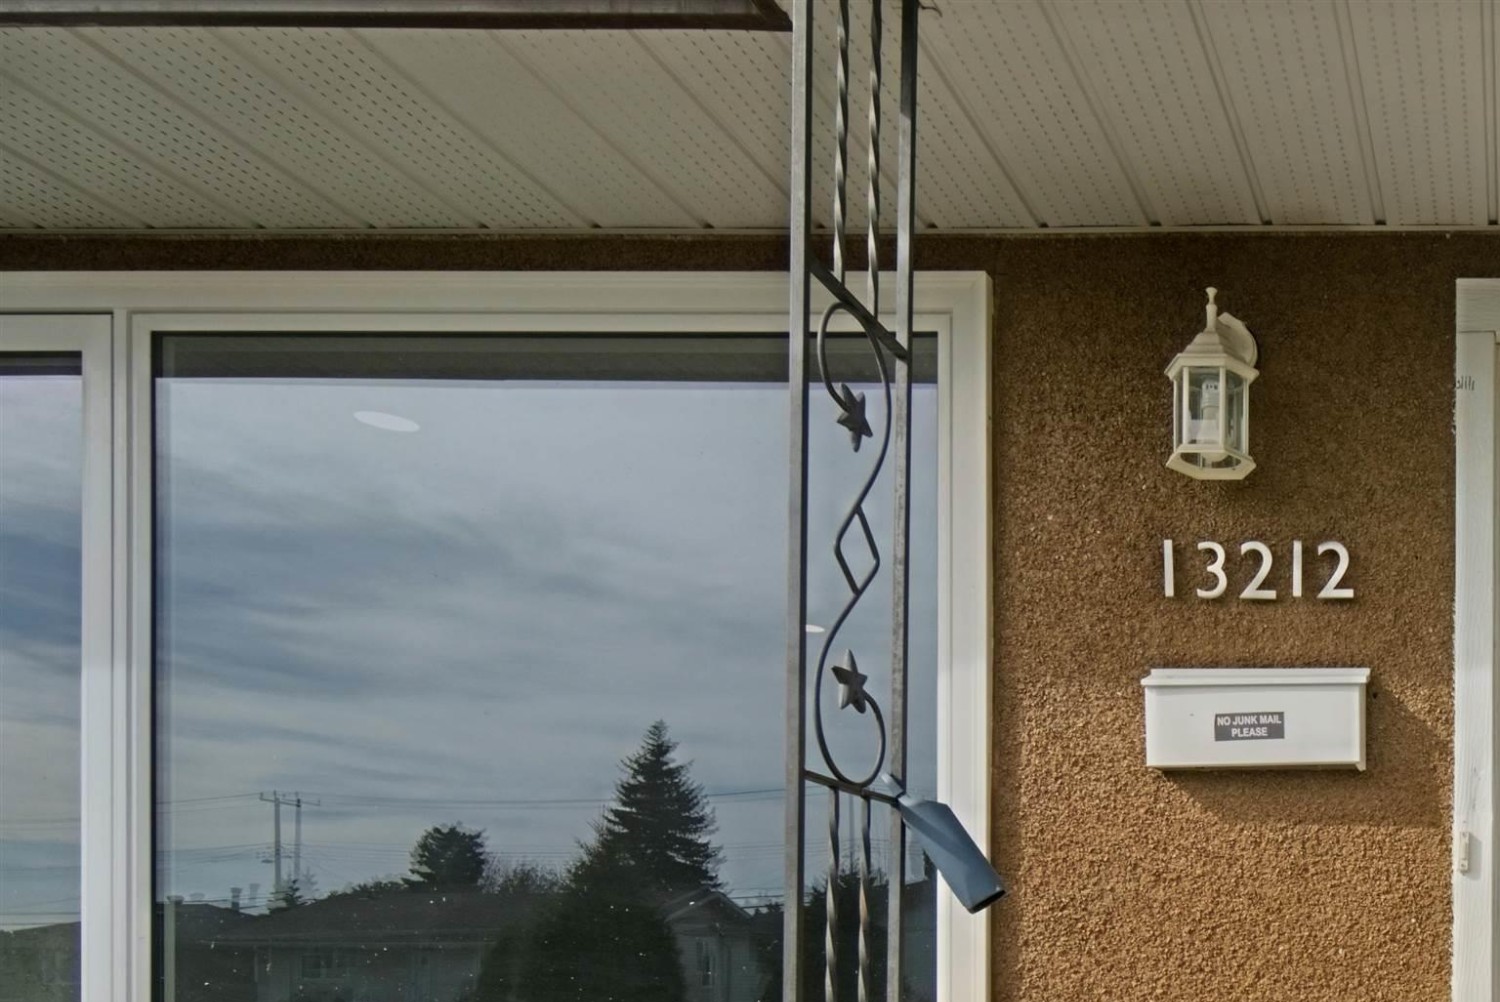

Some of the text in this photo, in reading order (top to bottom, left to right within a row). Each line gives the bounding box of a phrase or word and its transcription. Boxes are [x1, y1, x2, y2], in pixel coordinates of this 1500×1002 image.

[1163, 539, 1354, 600] 13212
[1217, 714, 1282, 726] NO JUNK MAIL
[1231, 727, 1268, 737] PLEASE
